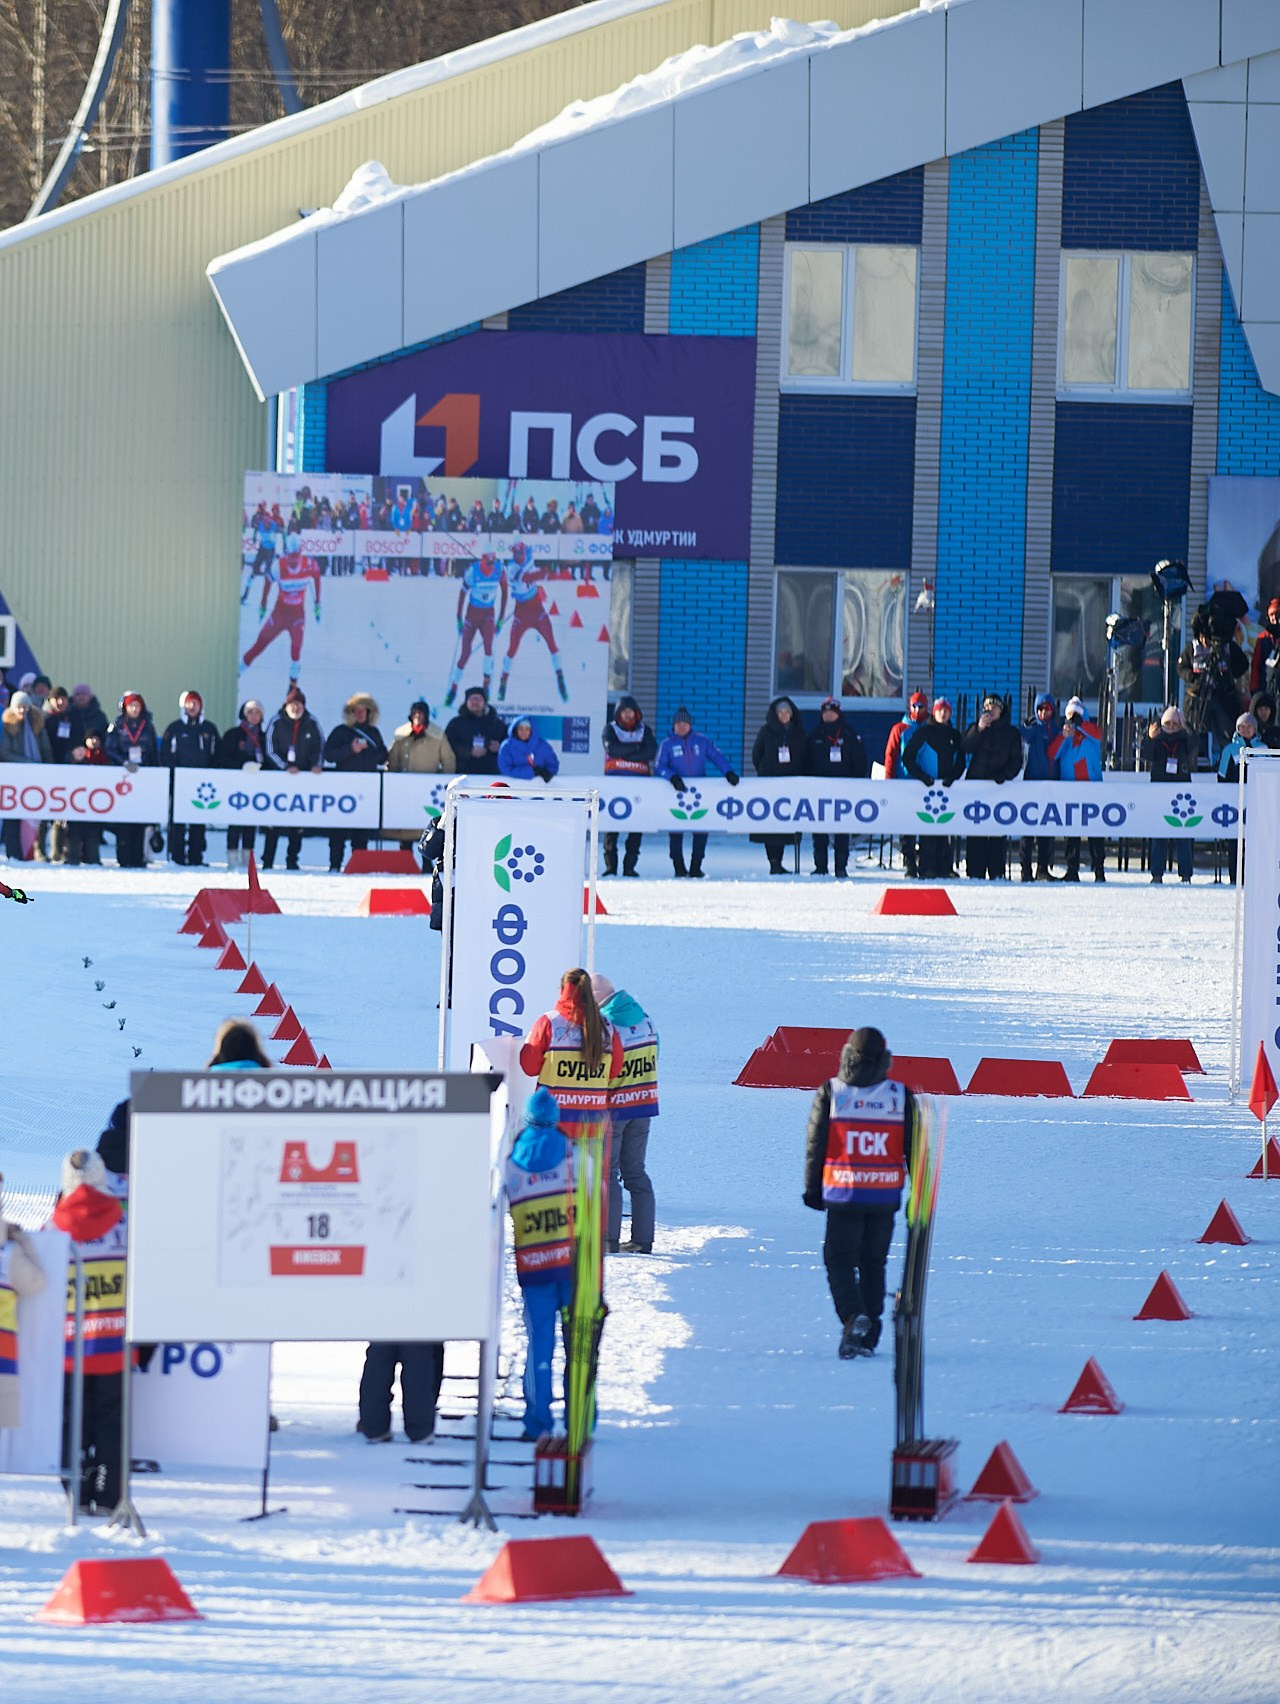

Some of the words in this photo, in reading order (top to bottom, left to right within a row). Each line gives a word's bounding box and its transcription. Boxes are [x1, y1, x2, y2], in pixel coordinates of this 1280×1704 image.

[509, 411, 698, 483] ПСБ
[299, 539, 336, 552] BOSCO
[366, 540, 404, 554] BOSCO
[433, 541, 470, 556] BOSCO
[627, 530, 697, 547] УДМУРТИИ
[0, 785, 115, 814] BOSCO
[228, 790, 358, 815] ФОСАГРО
[716, 796, 880, 823] ФОСАГРО
[963, 801, 1128, 828] ФОСАГРО
[181, 1078, 447, 1112] ИНФОРМАЦИЯ
[845, 1130, 889, 1157] ГСК
[832, 1169, 899, 1183] УДМУРТИЯ
[307, 1213, 330, 1239] 18
[524, 1205, 577, 1234] СУДЬЯ
